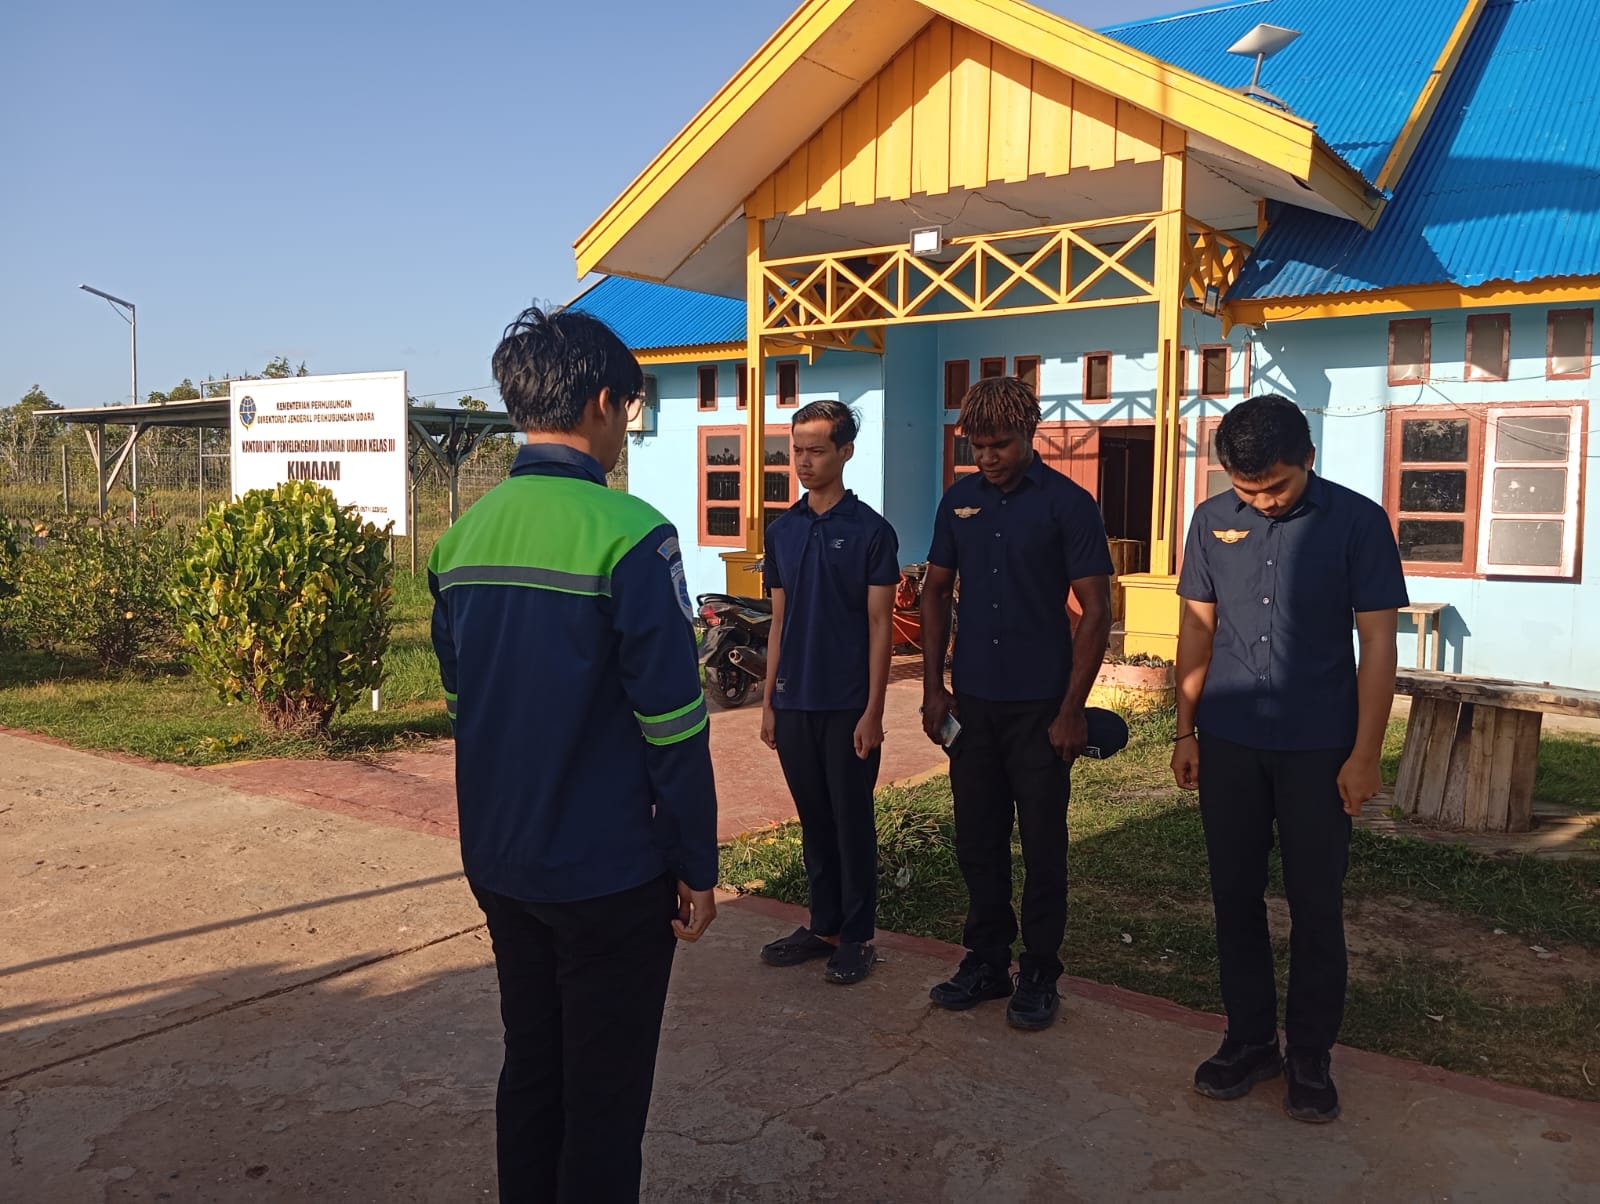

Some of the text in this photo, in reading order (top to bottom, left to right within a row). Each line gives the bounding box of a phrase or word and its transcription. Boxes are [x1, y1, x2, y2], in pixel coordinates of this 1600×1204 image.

[276, 400, 352, 410] KEMENTERIAN PERHUBUNGAN
[258, 412, 375, 424] DIREKTORAT JENDERAL PERHUBUNGAN UDARA
[242, 440, 262, 453] KANTOR
[264, 440, 276, 453] UNIT
[346, 439, 368, 453] UDARA
[368, 439, 388, 453] KELAS
[288, 461, 340, 480] KIMAAM
